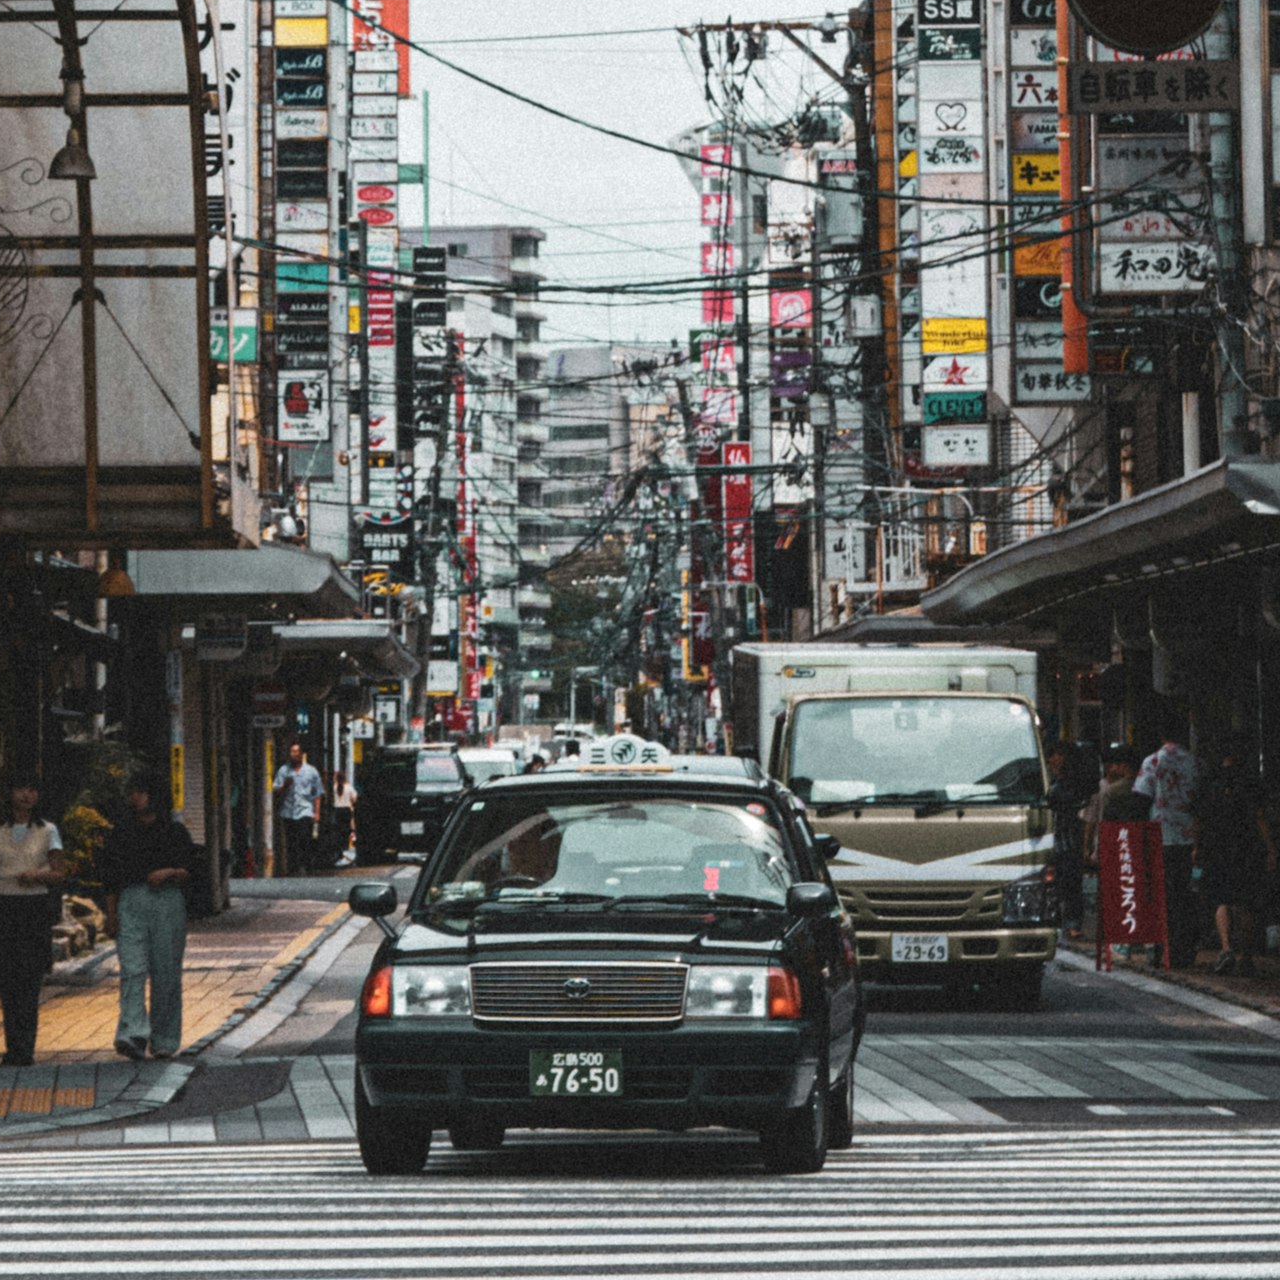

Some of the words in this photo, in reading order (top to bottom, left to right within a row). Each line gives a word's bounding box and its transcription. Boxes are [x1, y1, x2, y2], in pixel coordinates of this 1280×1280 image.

[929, 399, 983, 417] CLEVER
[641, 748, 658, 764] 矢
[904, 945, 945, 960] 29-69
[579, 1052, 603, 1066] 500
[550, 1068, 619, 1093] 76-50
